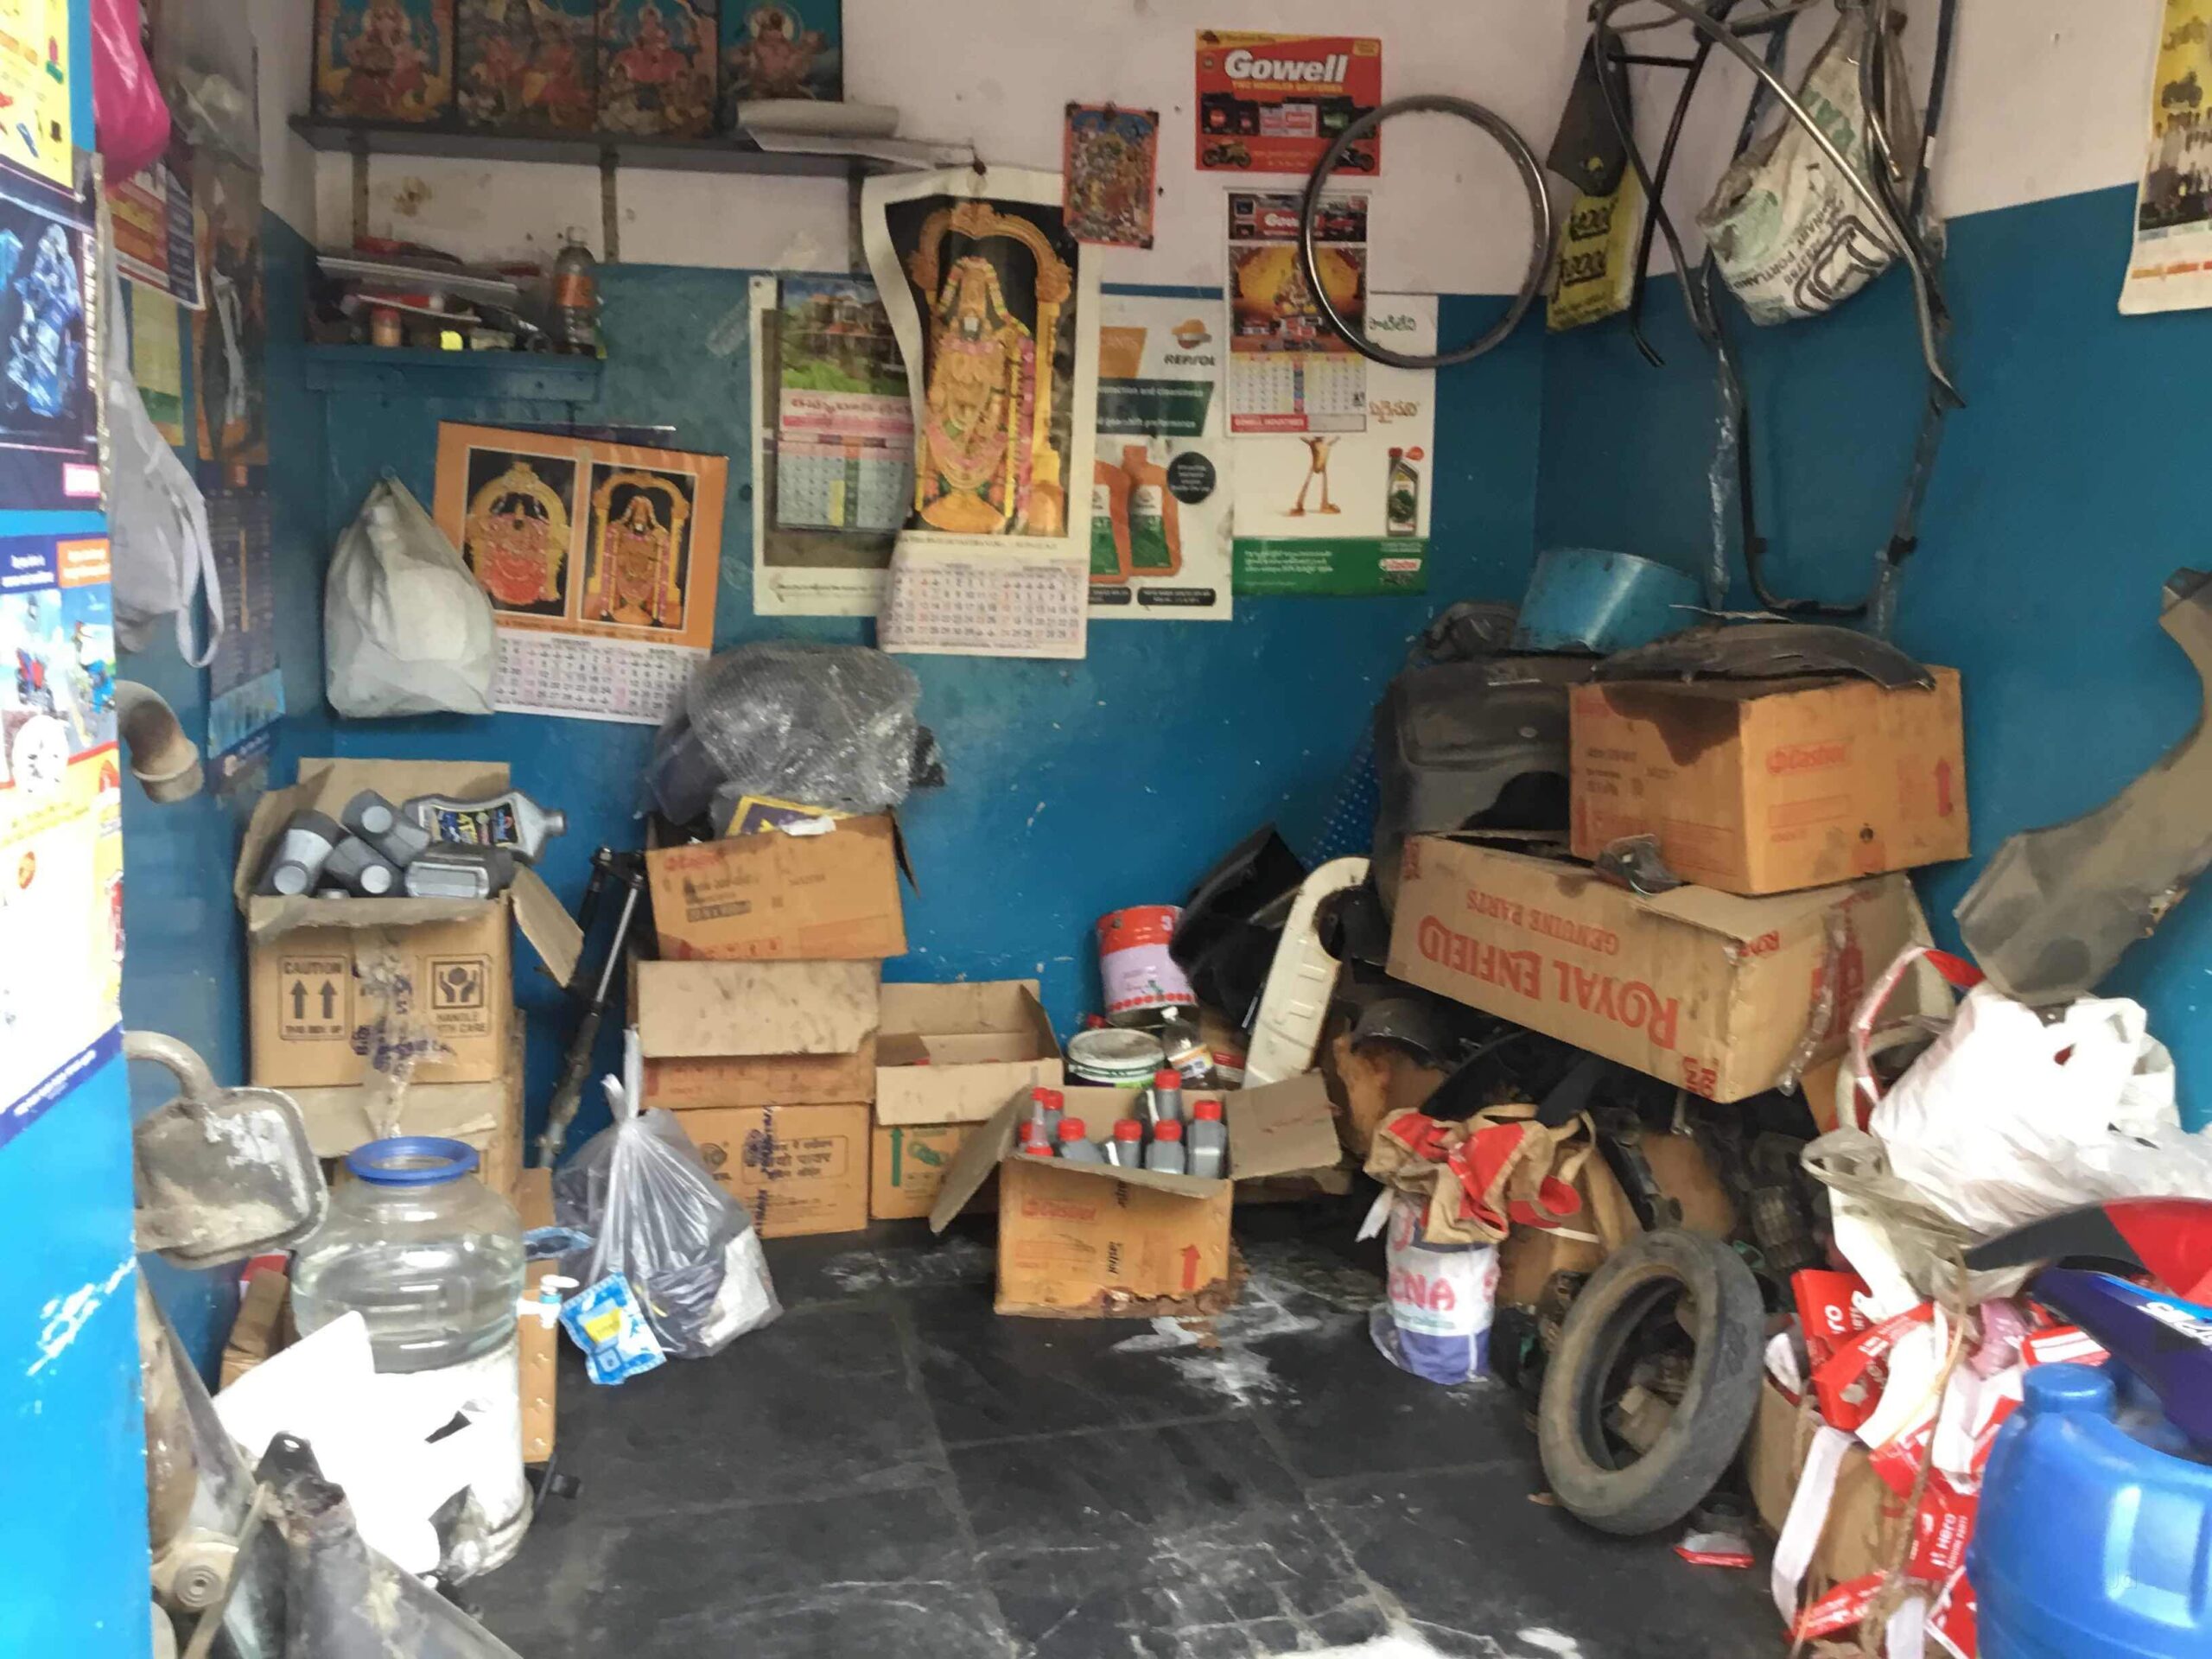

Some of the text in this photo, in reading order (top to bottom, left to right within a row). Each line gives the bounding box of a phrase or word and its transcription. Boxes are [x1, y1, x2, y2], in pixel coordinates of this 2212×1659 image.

[1224, 49, 1348, 82] Gowell
[1164, 355, 1215, 366] REPSOL
[283, 962, 342, 975] CAUTION
[1418, 915, 1681, 1051] ROYAL ENFIELD
